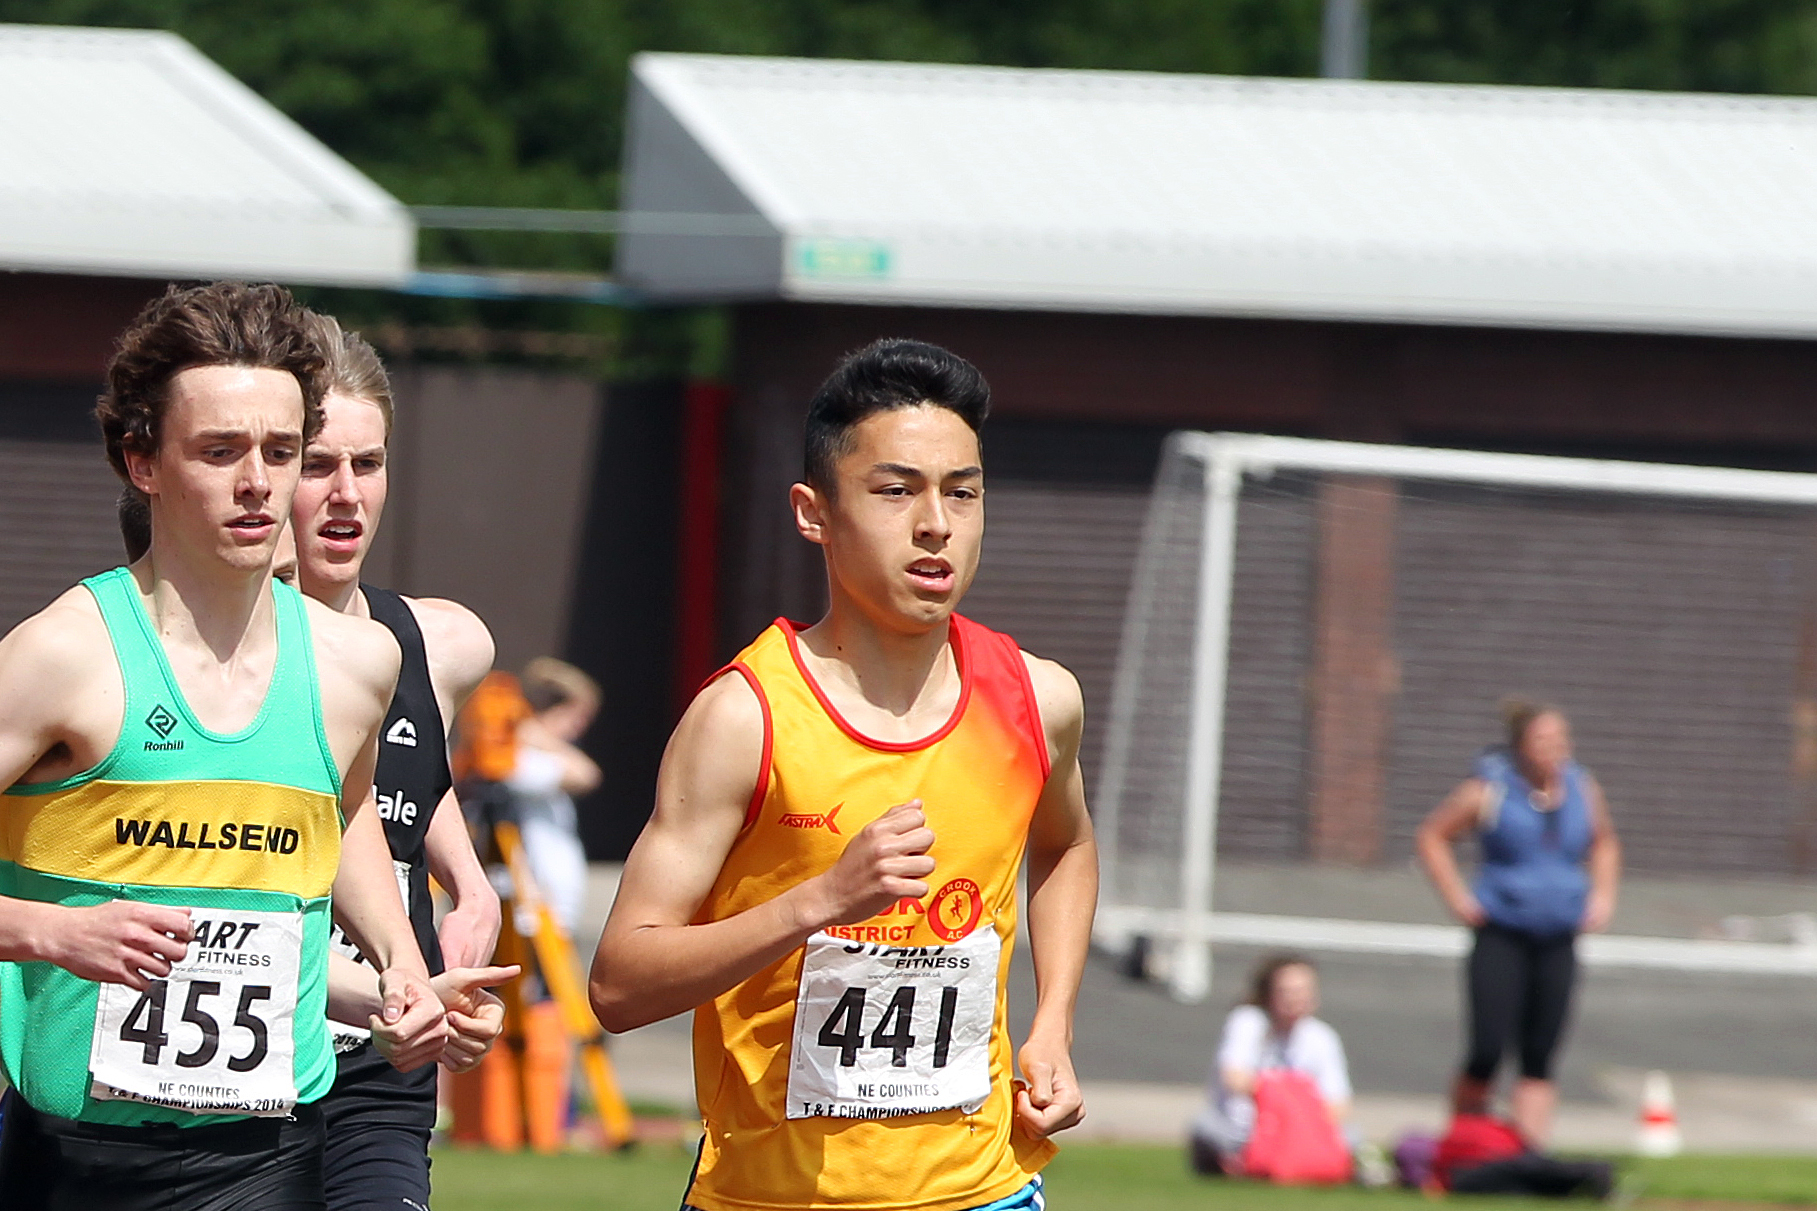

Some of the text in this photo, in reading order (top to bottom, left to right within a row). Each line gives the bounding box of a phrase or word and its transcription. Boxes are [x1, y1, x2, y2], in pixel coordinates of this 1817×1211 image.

[144, 741, 184, 751] Ronhill
[778, 801, 845, 835] FASTRAX
[116, 818, 299, 855] WALLSEND
[939, 881, 977, 898] CROOK
[186, 919, 261, 950] ART
[197, 951, 272, 967] FITNESS
[895, 957, 971, 969] FITNESS
[119, 978, 272, 1073] 455
[817, 985, 959, 1069] 441
[158, 1082, 240, 1099] NE COUNTIES
[858, 1083, 940, 1097] NE COUNTIES
[254, 1098, 285, 1112] 2014
[803, 1102, 811, 1115] T
[813, 1103, 824, 1117] &
